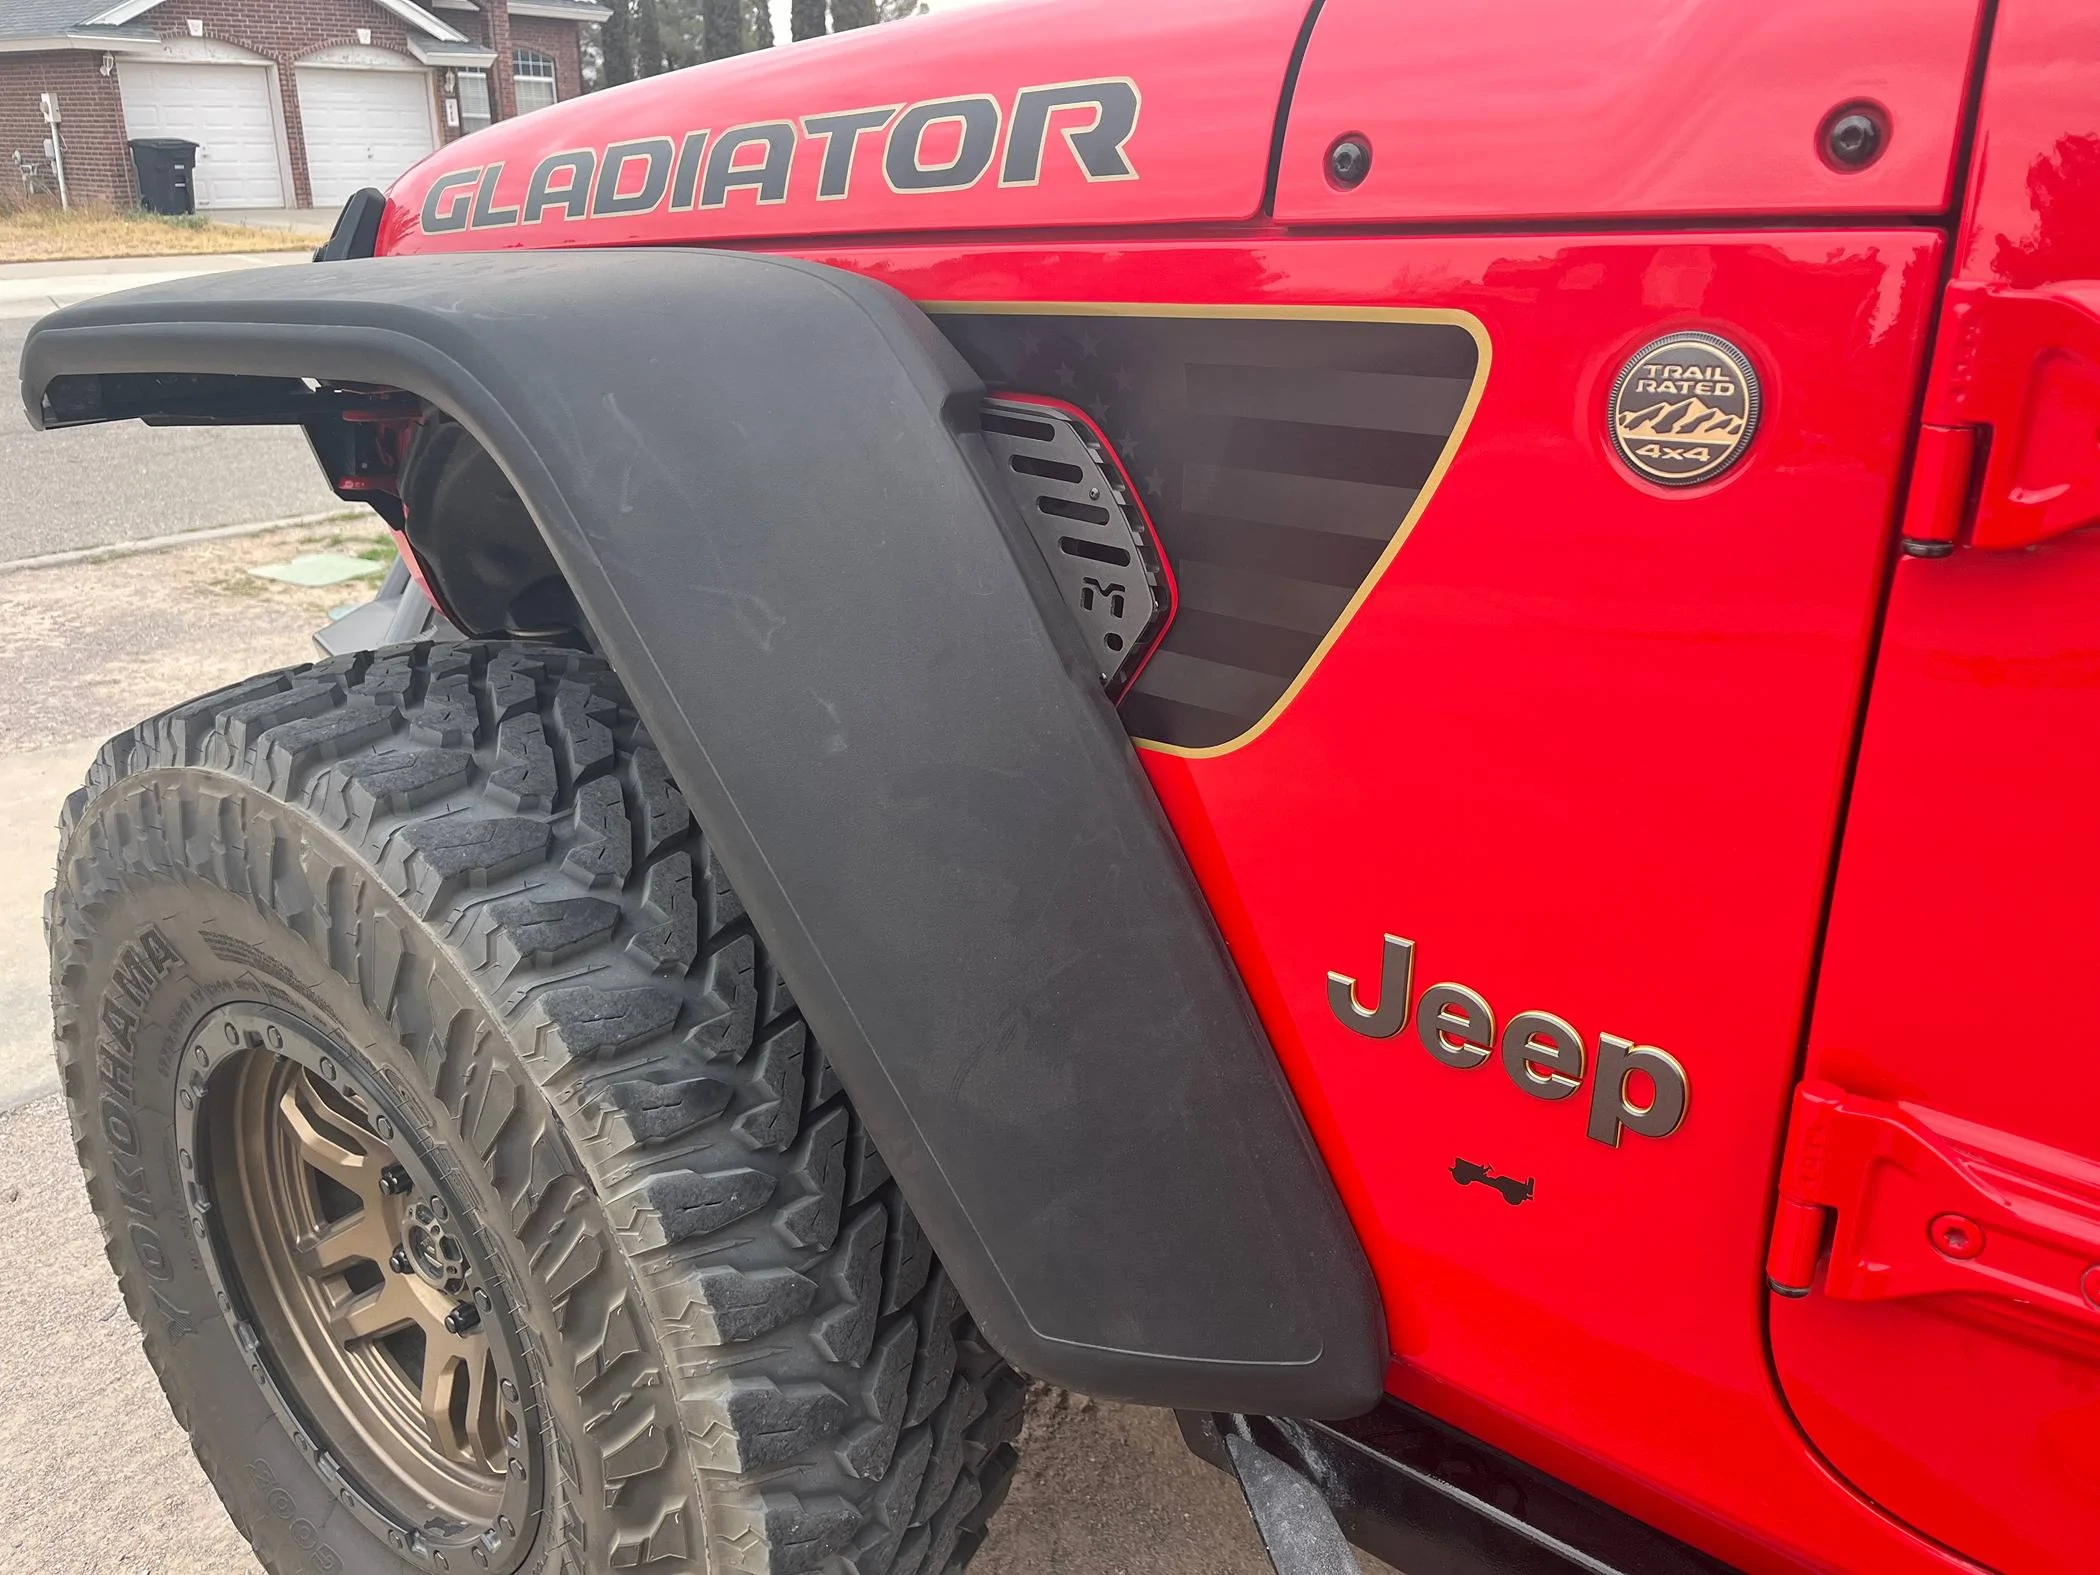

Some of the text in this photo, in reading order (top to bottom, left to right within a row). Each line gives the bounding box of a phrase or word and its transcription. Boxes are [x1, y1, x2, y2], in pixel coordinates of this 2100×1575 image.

[420, 77, 1141, 236] GLADIATOR
[1635, 379, 1736, 397] RATED
[1643, 364, 1731, 381] TRAIL
[1635, 444, 1711, 462] 4x4
[1326, 932, 1691, 1149] Jeep
[97, 921, 198, 1341] YOKOHAMA
